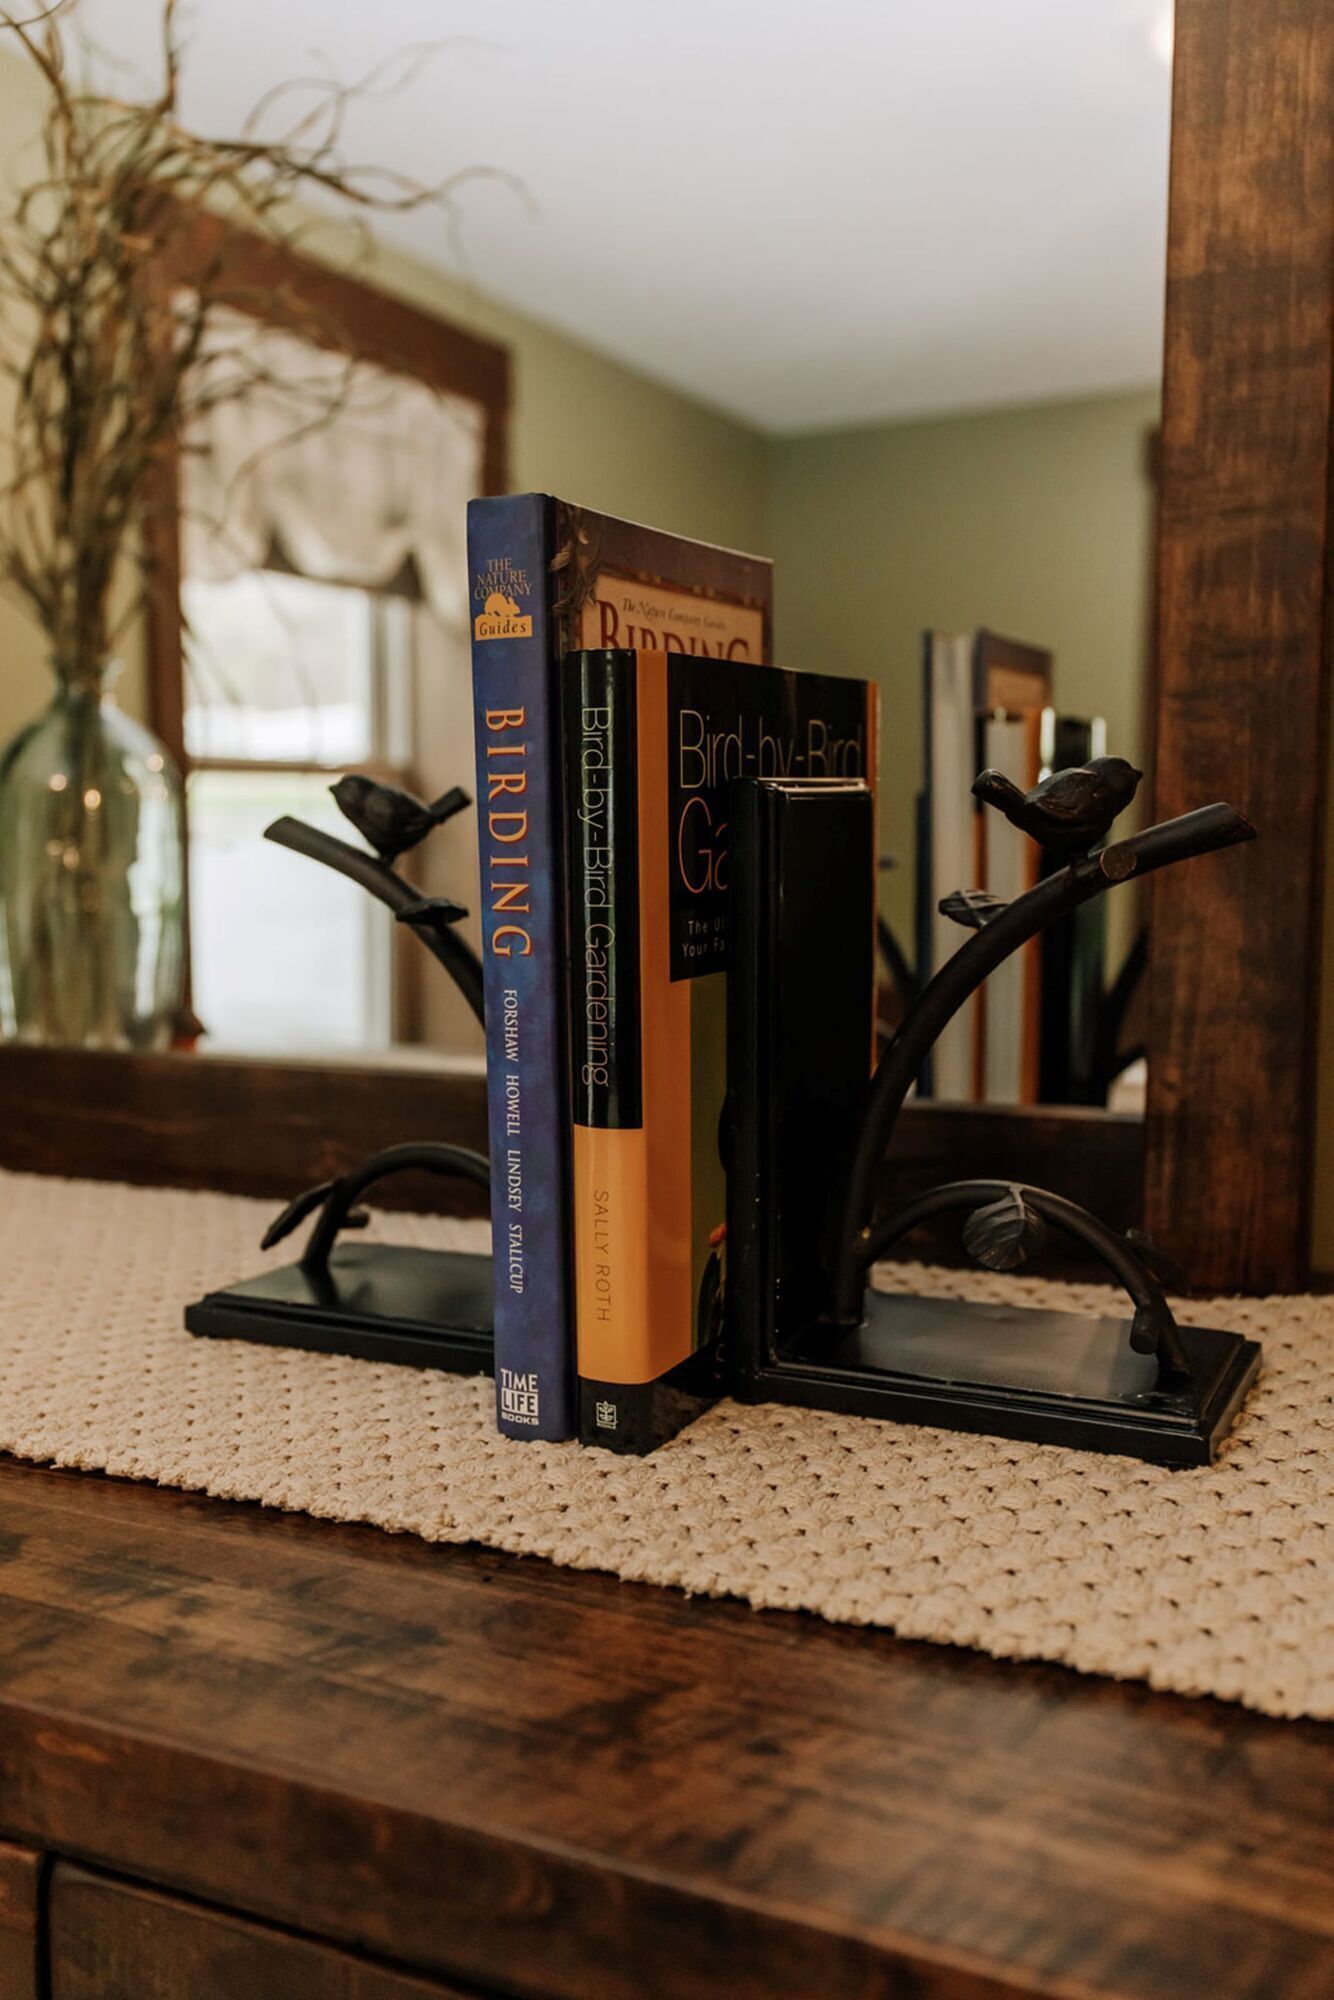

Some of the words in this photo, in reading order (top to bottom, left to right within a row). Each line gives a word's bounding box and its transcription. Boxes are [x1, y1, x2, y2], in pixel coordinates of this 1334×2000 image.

[476, 569, 526, 586] NATURE
[488, 557, 512, 572] THE
[474, 582, 532, 600] COMPANY
[623, 597, 636, 612] The
[479, 619, 526, 636] Guides
[577, 706, 614, 908] Bird-by-Bird
[485, 704, 533, 958] BIRDING
[688, 920, 708, 935] The
[681, 942, 708, 958] Your
[581, 923, 615, 1088] Gardening
[503, 988, 519, 1063] FORSHAW
[505, 1074, 521, 1137] HOWELL
[507, 1150, 523, 1212] LINDSEY
[593, 1189, 610, 1255] SALLY
[508, 1223, 524, 1294] STALLCUP
[595, 1264, 611, 1321] ROTH
[500, 1367, 539, 1392] TIME
[502, 1388, 538, 1415] LIFE
[501, 1411, 540, 1426] BOOKS
